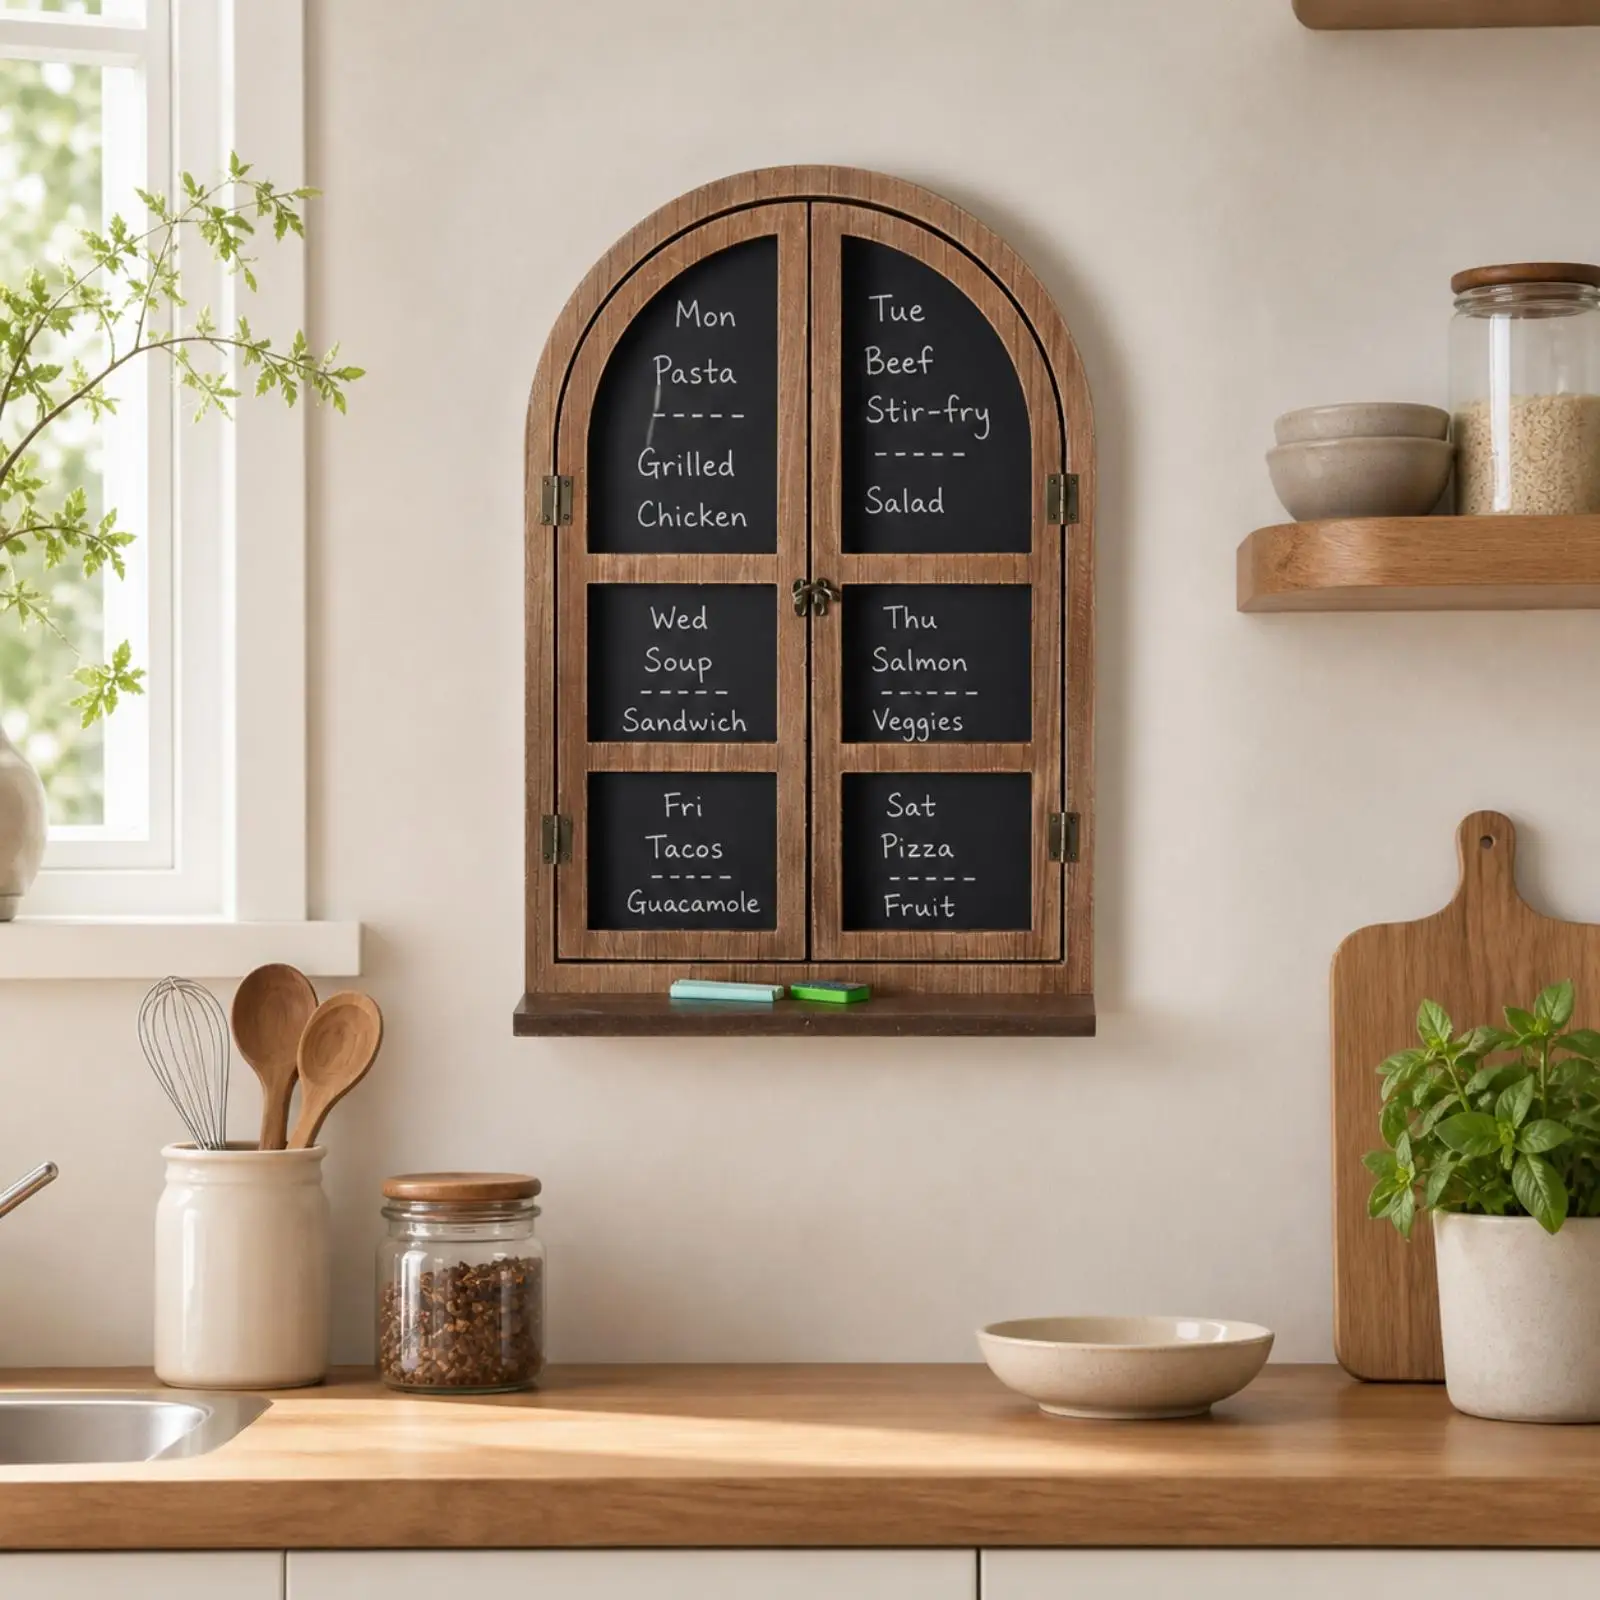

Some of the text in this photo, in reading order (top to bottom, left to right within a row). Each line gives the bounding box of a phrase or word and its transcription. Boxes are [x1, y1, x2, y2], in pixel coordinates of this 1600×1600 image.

[675, 299, 736, 328] Mon
[868, 293, 926, 322] Tue
[652, 354, 738, 386] Pasta
[865, 345, 934, 376] Beef
[865, 394, 991, 440] Stir-fry
[636, 446, 736, 478] Grilled
[636, 499, 748, 528] Chicken
[864, 485, 946, 514] Salad
[649, 604, 708, 630] Wed
[882, 604, 938, 629] Thu
[643, 646, 713, 684] Soup
[871, 646, 968, 673] Salmon
[622, 706, 747, 733] Sandwich
[872, 707, 964, 742] Veggies
[663, 791, 703, 818] Fri
[885, 791, 937, 818] Sat
[644, 833, 723, 860] Tacos
[880, 832, 955, 859] Pizza
[626, 888, 761, 915] Guacamole
[883, 893, 955, 918] Fruit
